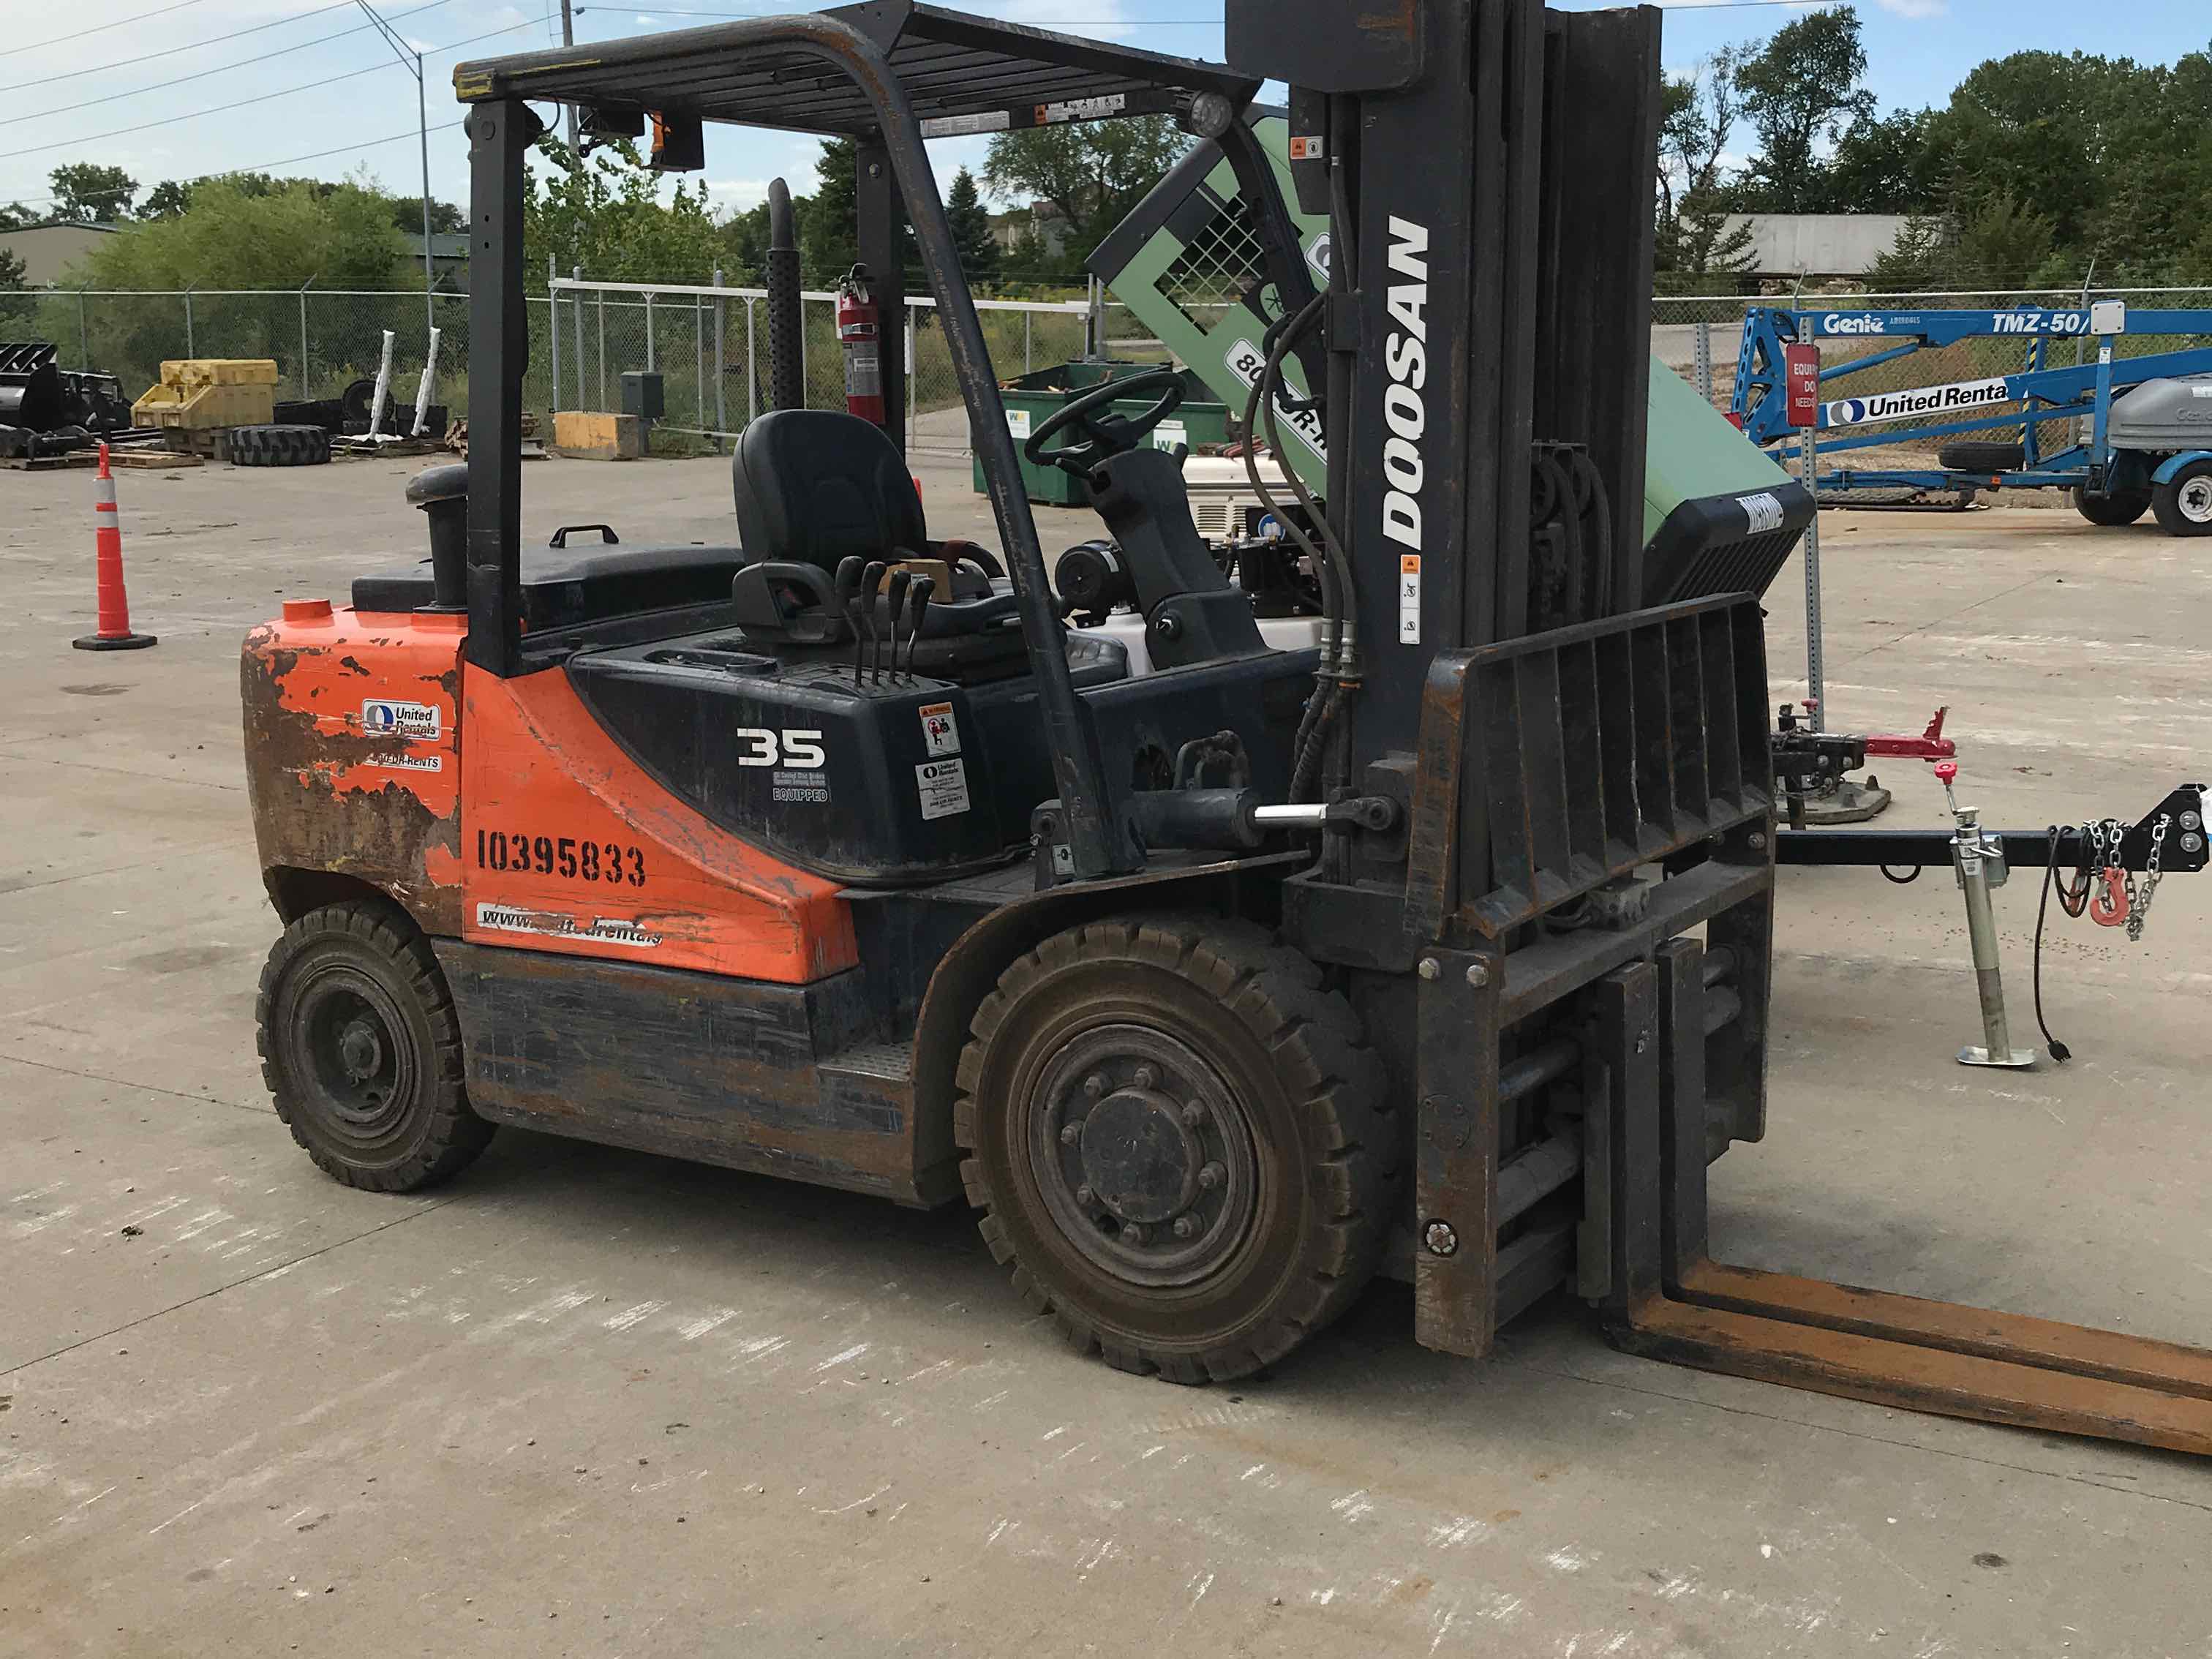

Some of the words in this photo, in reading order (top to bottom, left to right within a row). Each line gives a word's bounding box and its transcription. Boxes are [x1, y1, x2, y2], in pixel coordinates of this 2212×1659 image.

[1824, 313, 1884, 334] Genie
[1382, 215, 1429, 551] DOOSAN
[1869, 389, 1941, 417] United
[1944, 384, 2006, 406] Renta
[396, 707, 433, 721] United
[736, 727, 826, 769] 35
[772, 787, 828, 802] EQUIPPED
[478, 830, 646, 887] 10395833
